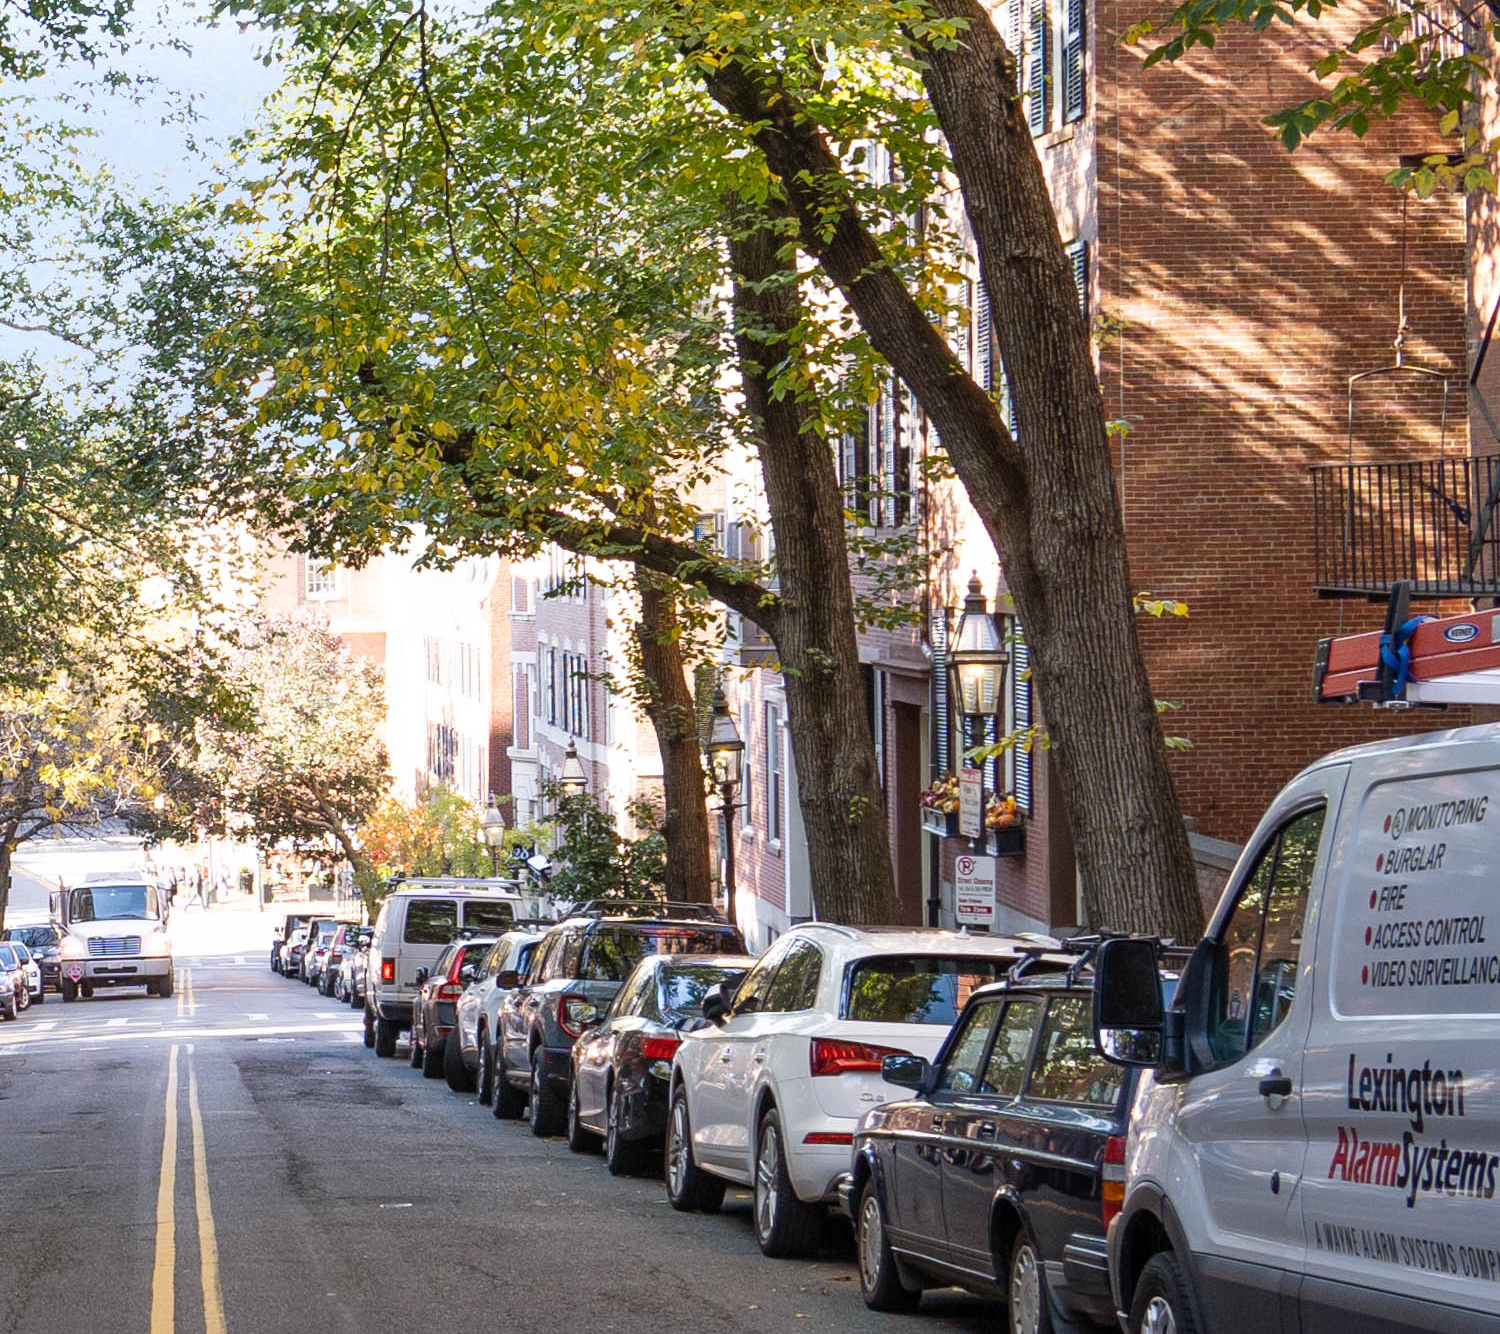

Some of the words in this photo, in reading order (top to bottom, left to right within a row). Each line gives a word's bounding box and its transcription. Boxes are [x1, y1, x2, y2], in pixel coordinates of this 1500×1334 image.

[1404, 796, 1489, 833] MONITORING
[1384, 843, 1446, 875] BURGLAR
[1377, 885, 1407, 911] FIRE
[1372, 921, 1423, 949] ACCESS
[1425, 916, 1486, 947] CONTROL
[1371, 960, 1407, 987] VIDEO
[1348, 1053, 1465, 1133] Lexington
[1328, 1126, 1500, 1208] AlarmSystems
[1314, 1221, 1323, 1250] A
[1323, 1222, 1360, 1257] WAYNE
[1361, 1228, 1399, 1264] ALARM
[1401, 1236, 1458, 1275] SYSTEMS
